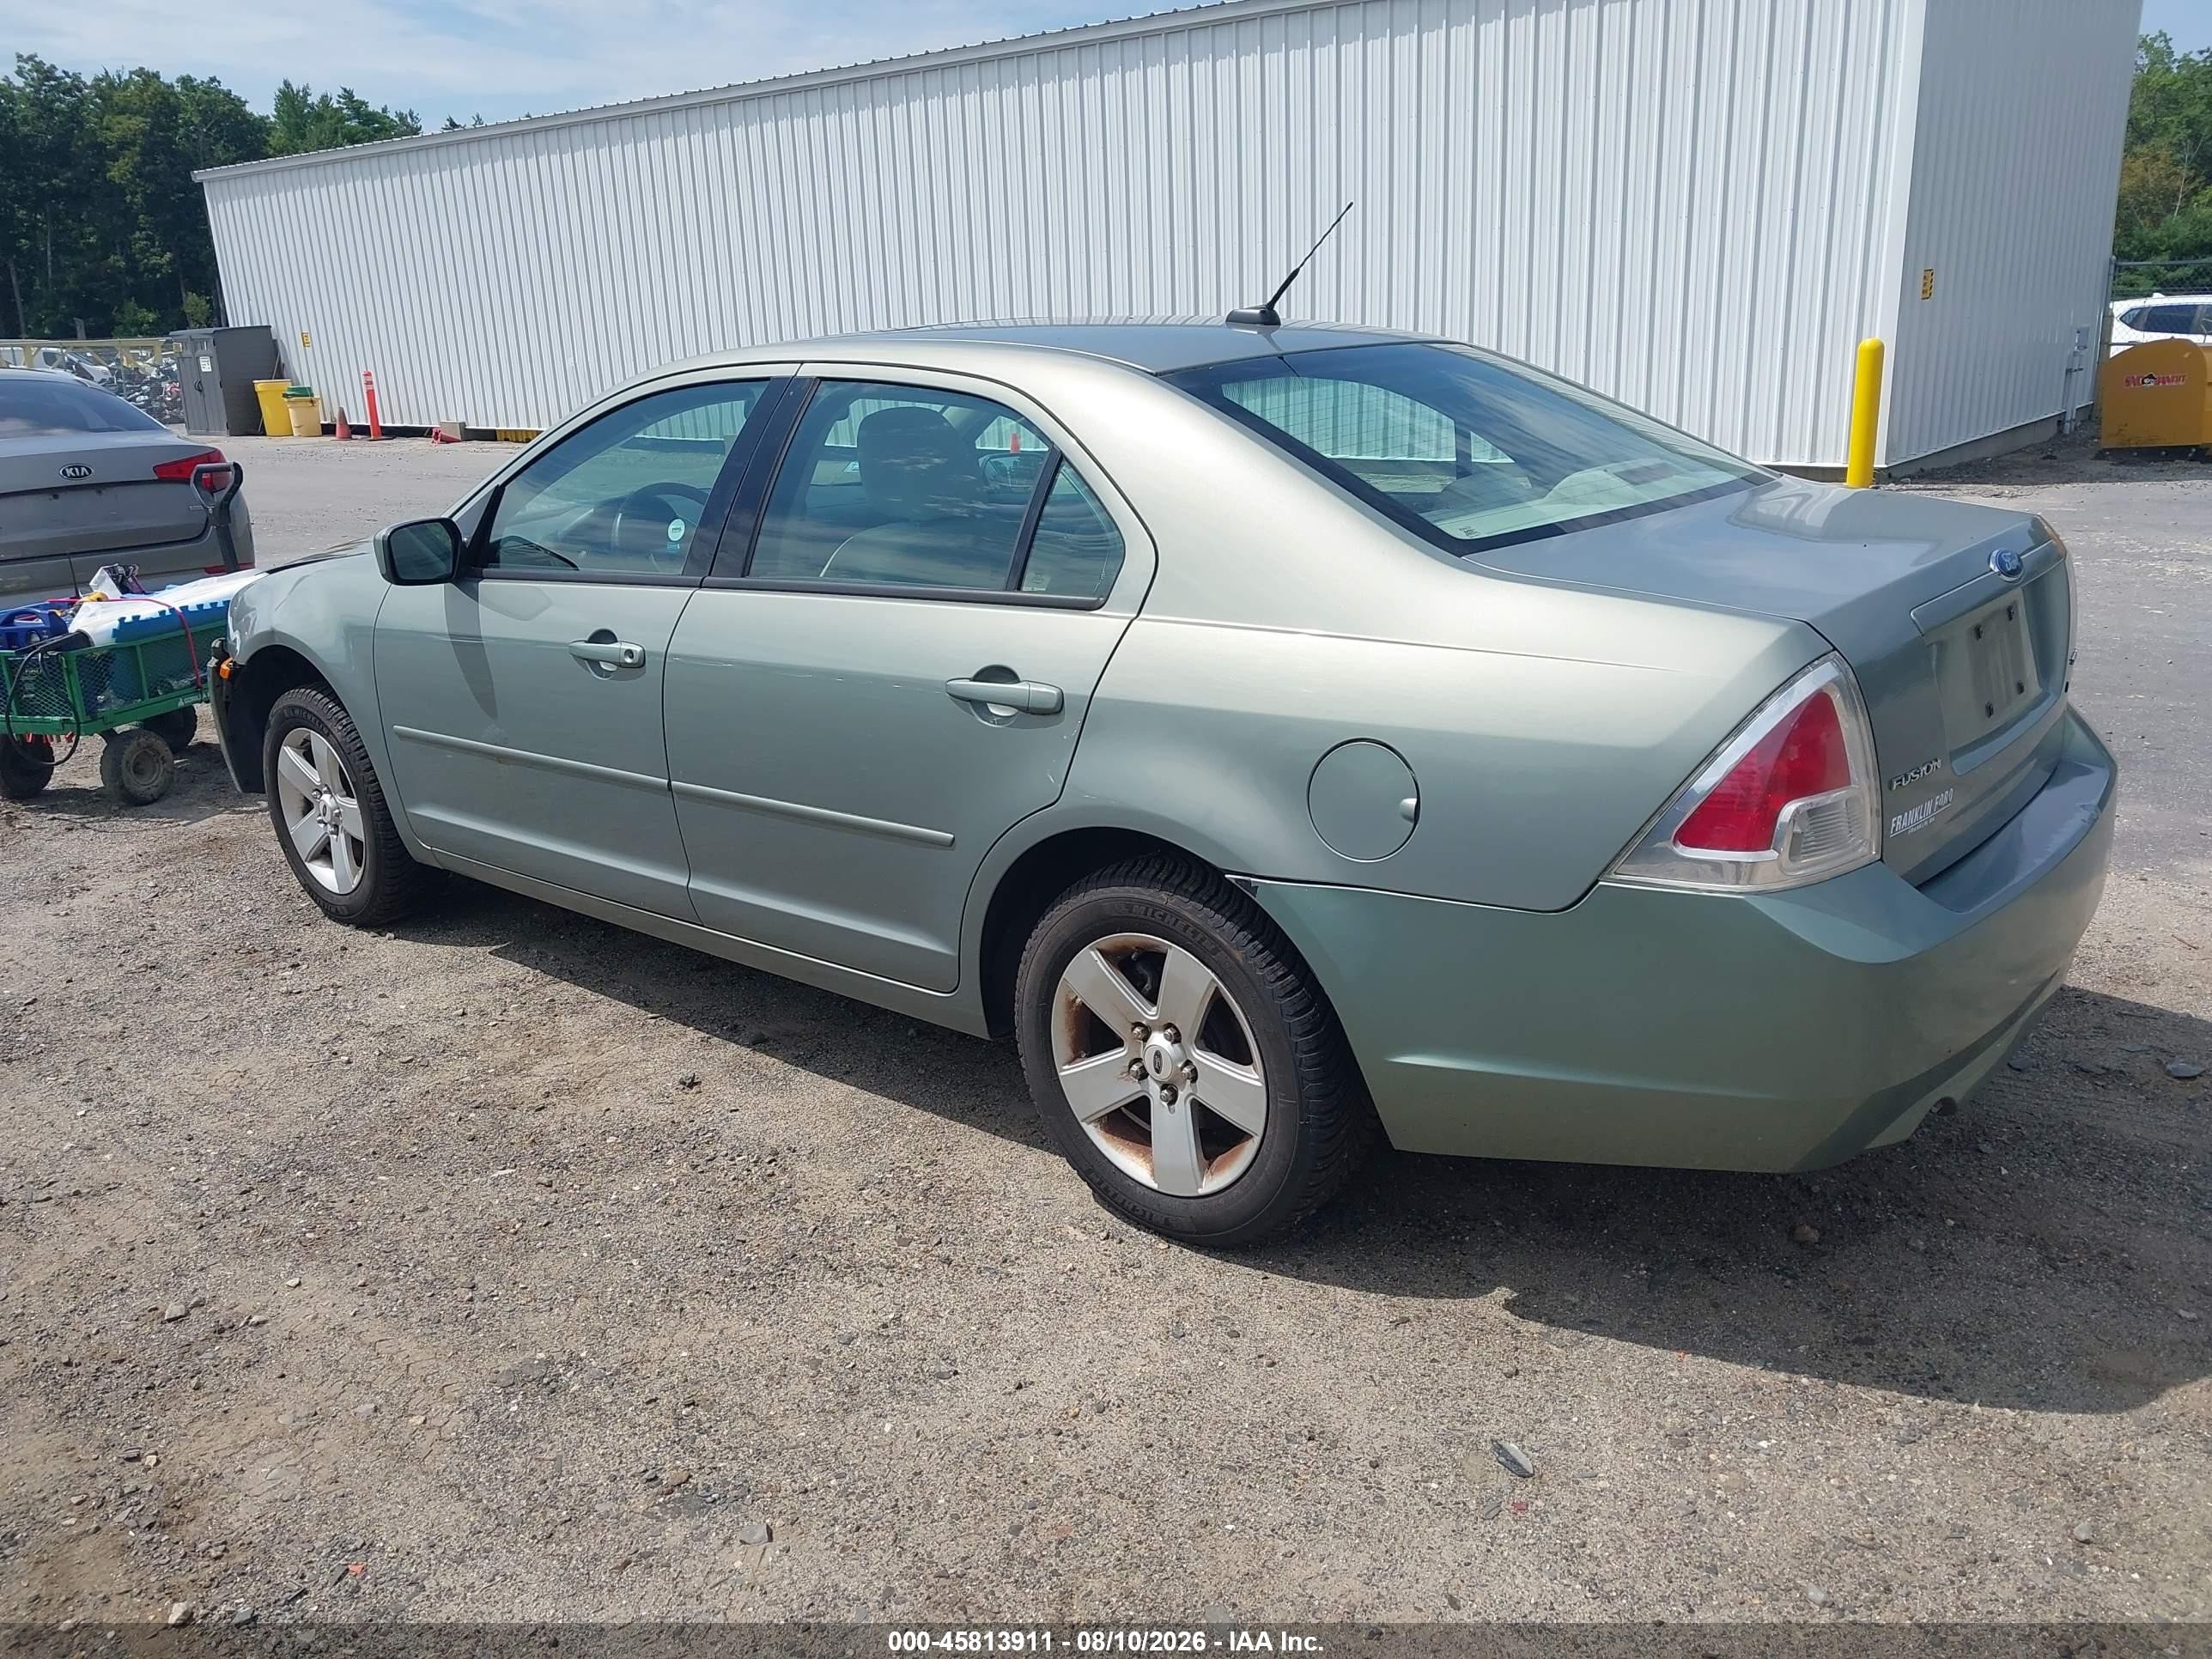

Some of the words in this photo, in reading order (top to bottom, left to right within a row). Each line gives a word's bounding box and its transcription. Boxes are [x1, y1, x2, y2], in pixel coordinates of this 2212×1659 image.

[64, 466, 90, 477] KIA
[1890, 757, 1942, 791] FUSION
[1890, 799, 1935, 835] FRANKLIN
[1934, 787, 1954, 812] FORD
[1132, 904, 1222, 957] MICHELIN
